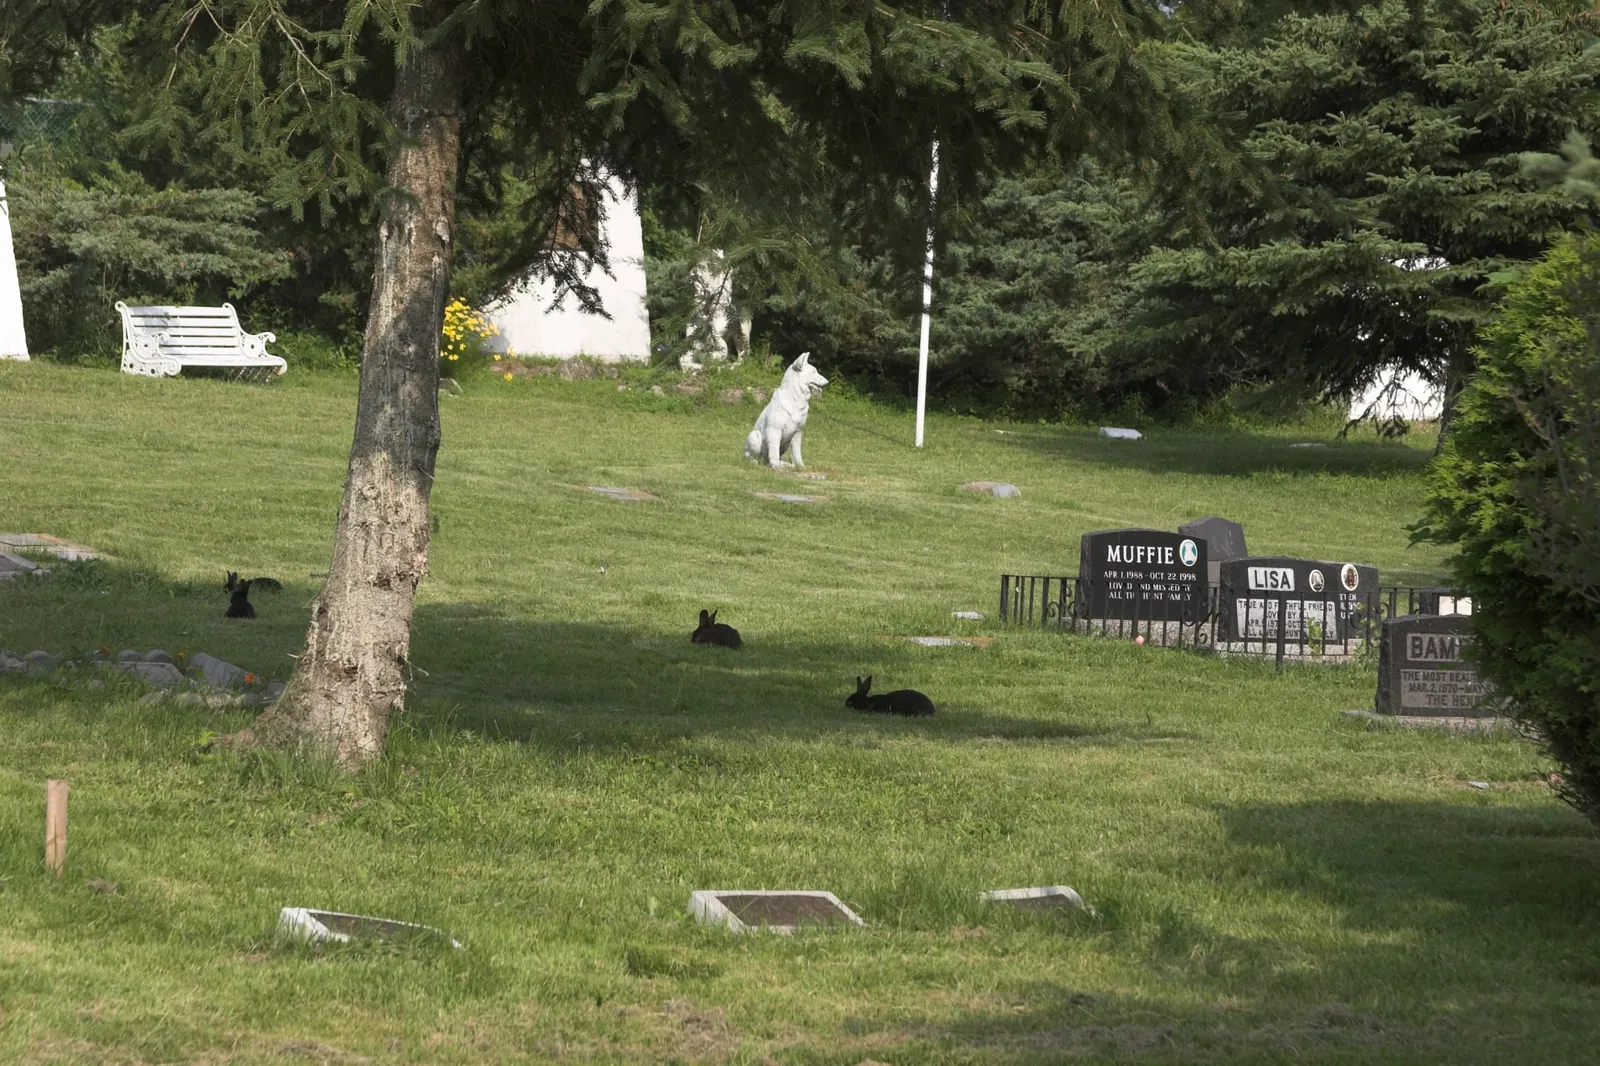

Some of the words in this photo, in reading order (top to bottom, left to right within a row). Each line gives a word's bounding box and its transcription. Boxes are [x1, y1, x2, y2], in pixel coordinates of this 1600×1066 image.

[1107, 545, 1174, 564] MUFFIE
[1180, 572, 1196, 581] 1998
[1254, 569, 1291, 589] LISA
[1259, 601, 1273, 609] AD
[1308, 603, 1332, 611] FRIED
[1411, 636, 1460, 660] BAM
[1402, 670, 1419, 681] THE
[1421, 671, 1446, 682] MOST
